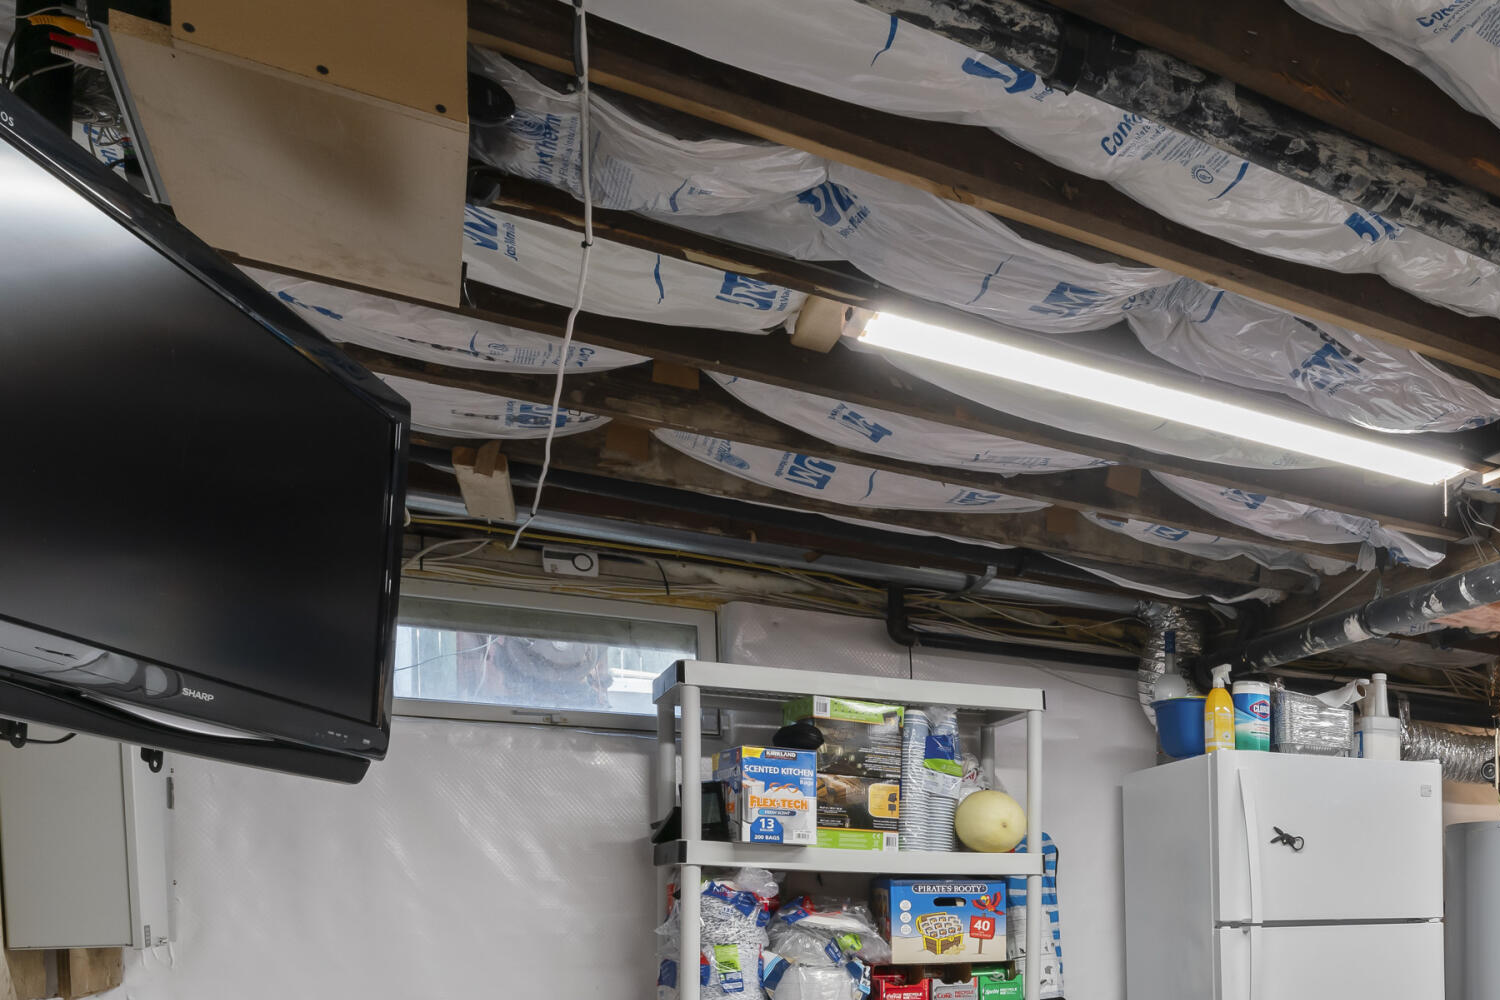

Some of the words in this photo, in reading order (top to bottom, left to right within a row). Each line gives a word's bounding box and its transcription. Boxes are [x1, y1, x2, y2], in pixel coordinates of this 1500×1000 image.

[182, 687, 215, 702] SHARP
[744, 764, 780, 775] SCENTED
[781, 766, 814, 778] KITCHEN
[760, 818, 775, 829] 13
[918, 884, 954, 893] PIRATE'S
[954, 884, 982, 893] BOOTY
[974, 920, 991, 931] 40
